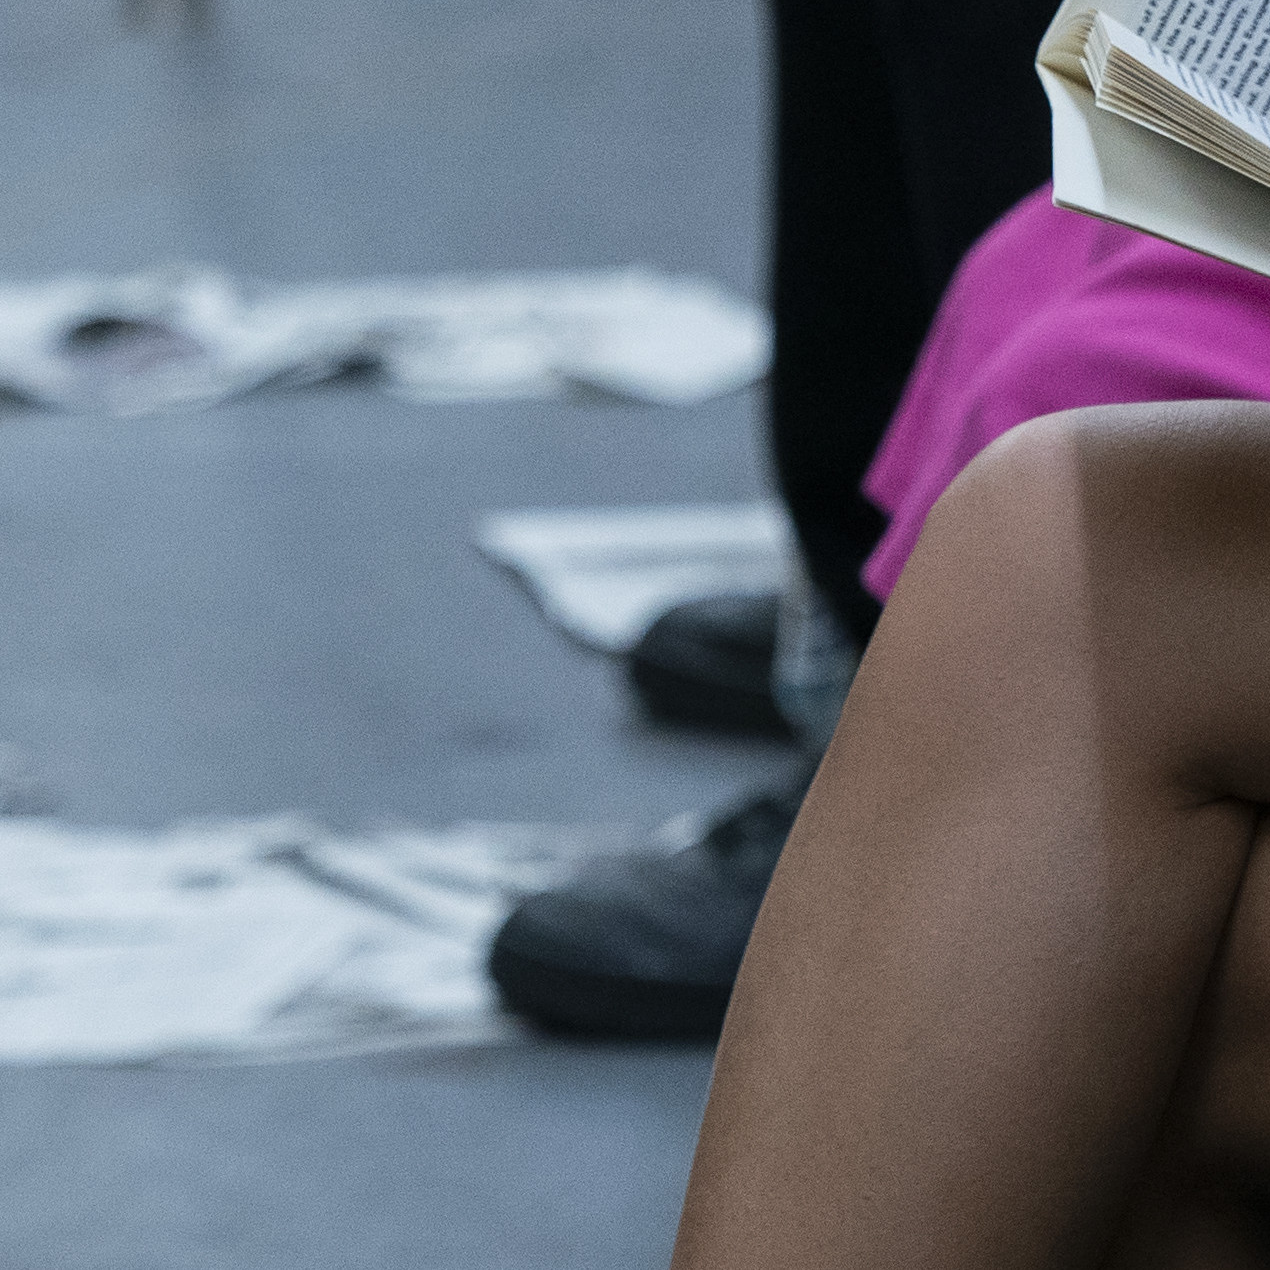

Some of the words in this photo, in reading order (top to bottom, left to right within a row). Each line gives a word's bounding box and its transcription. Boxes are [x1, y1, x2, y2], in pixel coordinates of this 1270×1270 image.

[1164, 27, 1182, 47] the
[1177, 0, 1196, 25] way
[1191, 8, 1209, 31] Her
[1193, 38, 1213, 64] man
[1231, 41, 1248, 62] the
[1252, 36, 1269, 57] the
